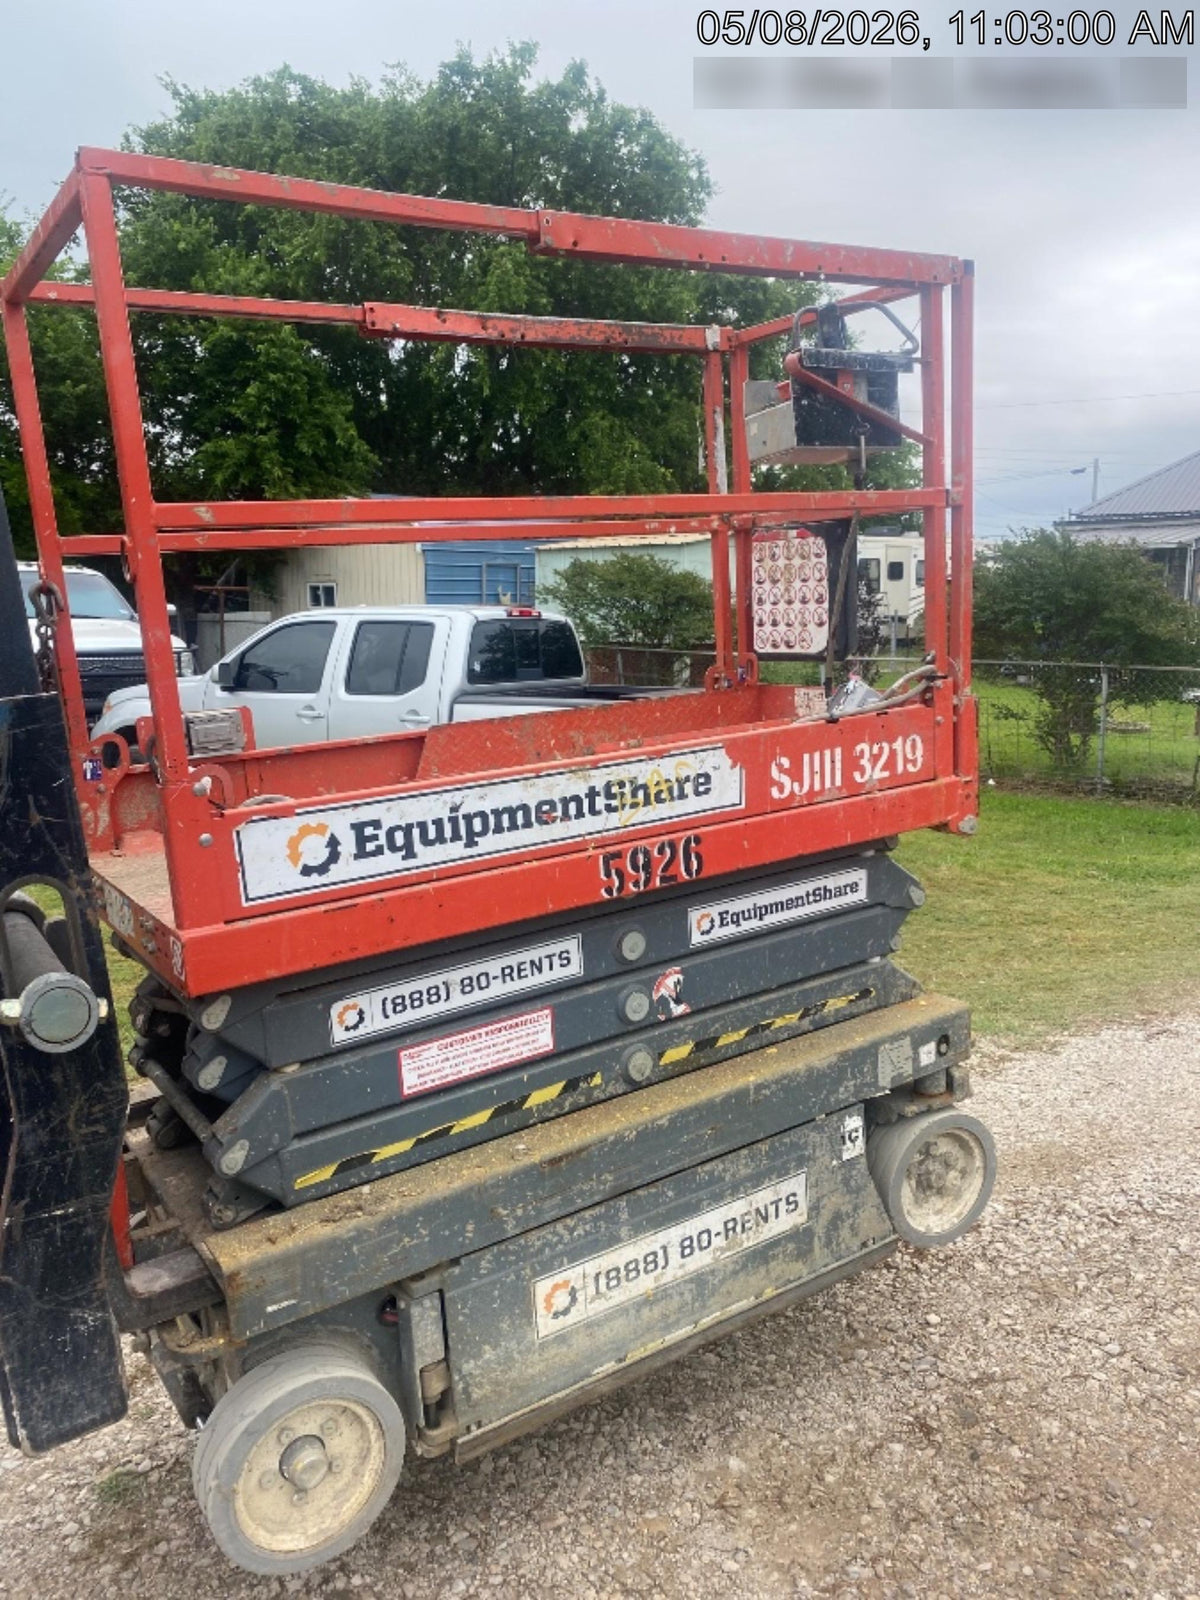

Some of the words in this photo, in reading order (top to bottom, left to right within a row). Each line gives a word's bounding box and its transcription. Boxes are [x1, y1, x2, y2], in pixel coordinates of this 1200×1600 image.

[852, 733, 924, 784] 3219
[351, 769, 713, 861] EquipmentShare
[600, 834, 703, 898] 5926
[717, 880, 860, 928] EquipmentShare
[381, 979, 450, 1019] (888)
[459, 949, 572, 995] 80-RENTS
[592, 1244, 670, 1296] (888)
[679, 1191, 800, 1261] 80-RENTS
